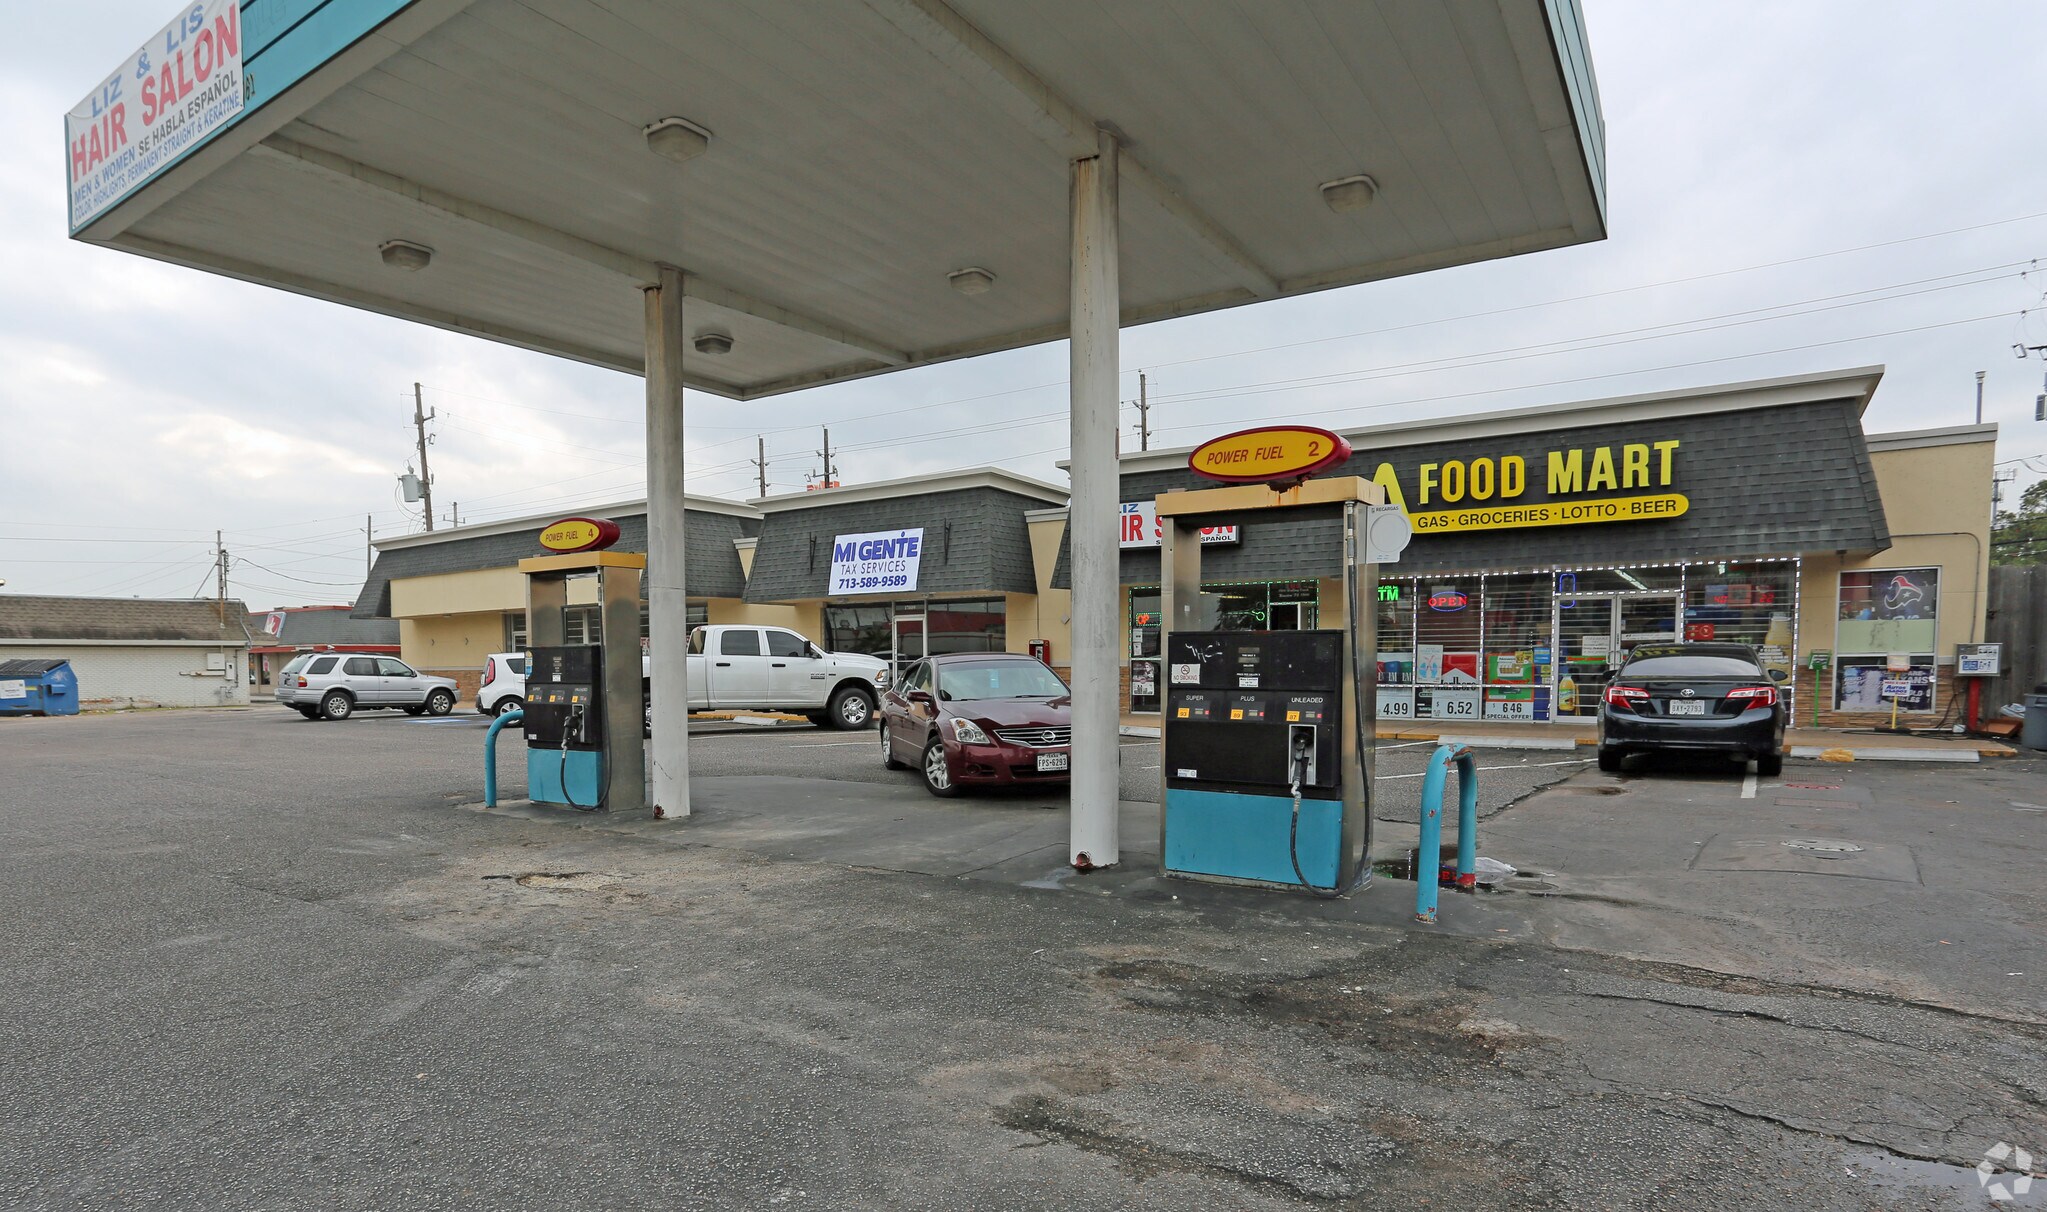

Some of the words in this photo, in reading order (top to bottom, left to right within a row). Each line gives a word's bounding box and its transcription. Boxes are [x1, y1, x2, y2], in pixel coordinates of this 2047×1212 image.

[92, 74, 123, 118] LIZ
[135, 52, 151, 80] &
[166, 4, 204, 55] LIS
[71, 102, 128, 183] HAIR
[141, 3, 238, 127] SALON
[74, 182, 92, 202] MEN
[94, 175, 101, 189] &
[102, 146, 135, 182] WOMEN
[138, 133, 150, 157] SE
[152, 114, 185, 149] HABLA
[187, 70, 238, 120] ESPAÑOL
[127, 151, 163, 183] PERMANENT
[163, 126, 195, 157] STRAIGHT
[197, 122, 203, 134] &
[1206, 449, 1249, 465] POWER
[1254, 446, 1284, 461] FUEL
[1308, 440, 1320, 457] 2
[1419, 455, 1525, 505] FOOD
[1547, 440, 1680, 495] MART
[1119, 503, 1139, 513] IZ
[1417, 515, 1449, 528] GAS
[1458, 508, 1550, 526] GROCERIES
[1561, 503, 1617, 519] LOTTO
[1631, 500, 1677, 514] BEER
[545, 532, 563, 542] POWER
[565, 530, 578, 540] FUEL
[588, 528, 593, 538] 4
[834, 542, 857, 562] MI
[858, 532, 919, 561] GENTE
[841, 563, 858, 575] TAX
[861, 560, 906, 574] SERVICES
[838, 575, 908, 589] 713-589-9589
[1378, 589, 1399, 601] TM
[1428, 596, 1468, 607] OPEN
[1383, 702, 1408, 715] 4.99
[1447, 701, 1473, 715] 6.52
